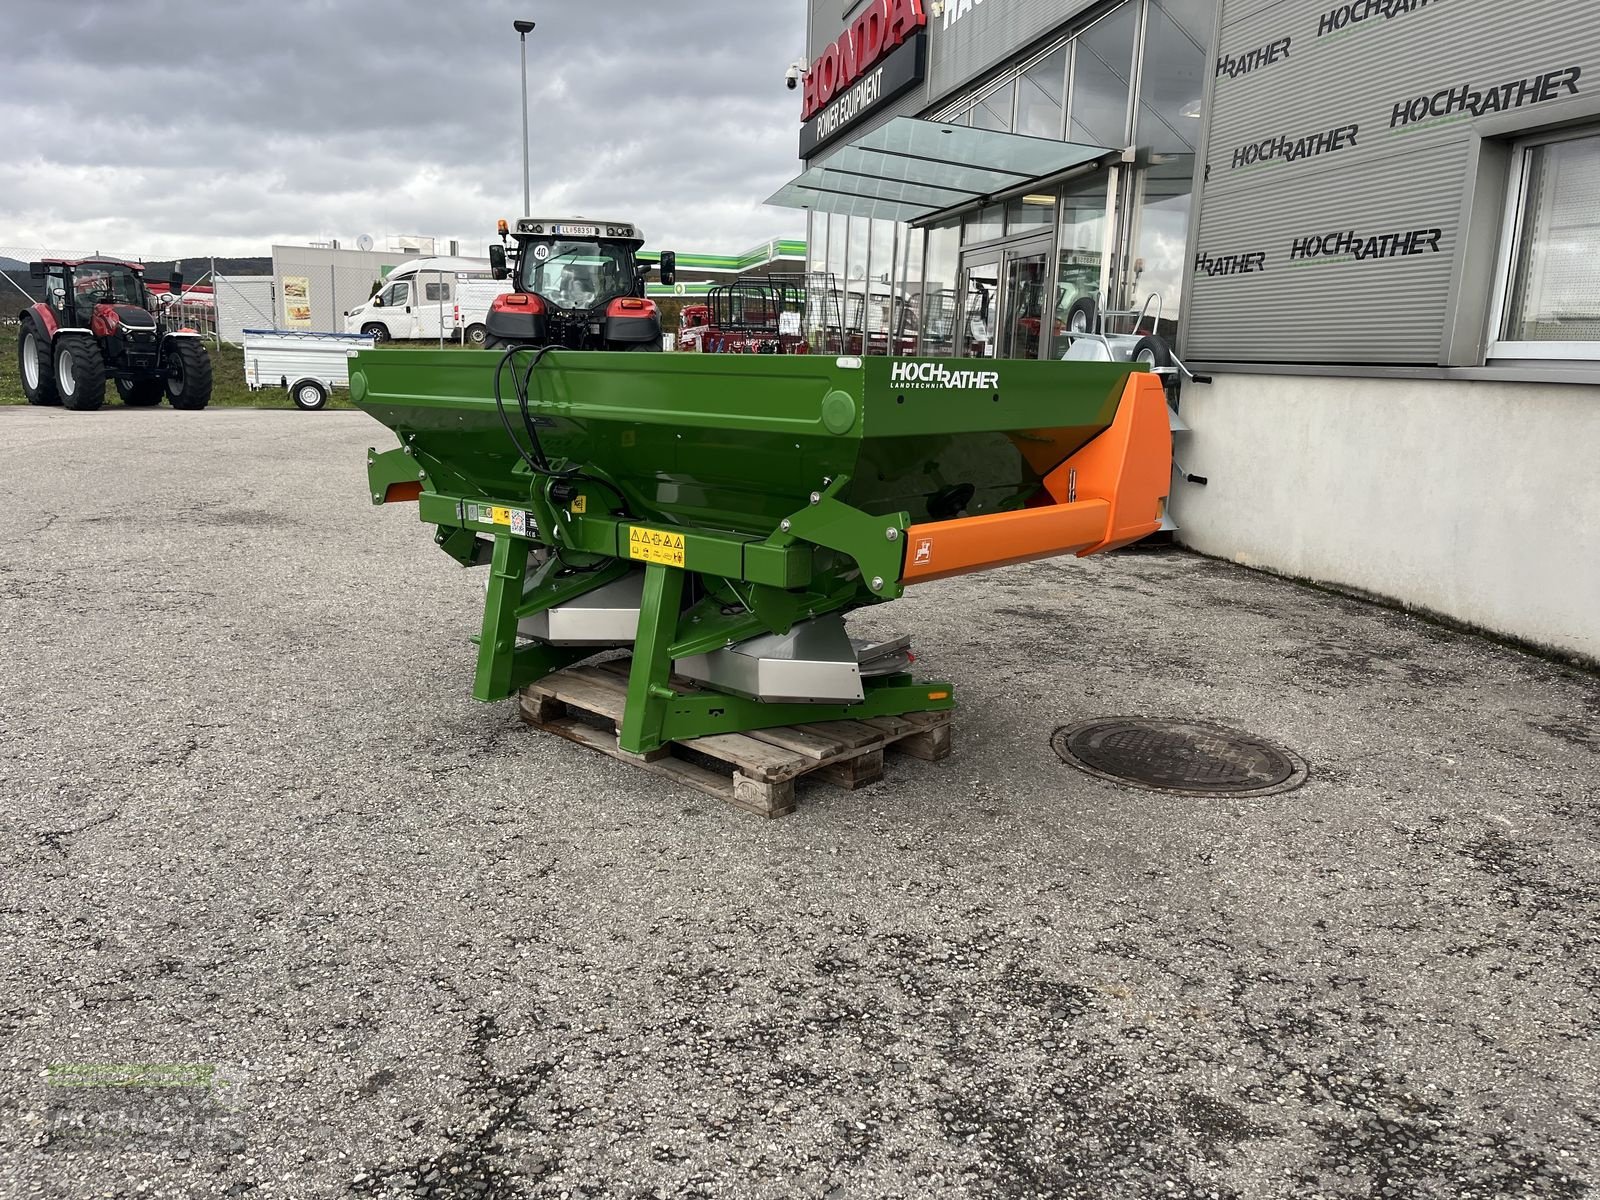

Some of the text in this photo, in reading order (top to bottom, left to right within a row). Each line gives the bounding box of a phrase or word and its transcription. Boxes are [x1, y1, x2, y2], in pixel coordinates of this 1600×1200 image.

[943, 0, 983, 31] HA
[801, 0, 926, 122] HONDA
[816, 67, 883, 141] POWER EQUIPMENT
[1390, 66, 1581, 128] HOCHRATHER
[1231, 123, 1359, 169] HOCHRATHER
[536, 247, 546, 258] 40
[1290, 228, 1442, 260] HOCHRATHER
[891, 361, 999, 389] HOCHRATHER
